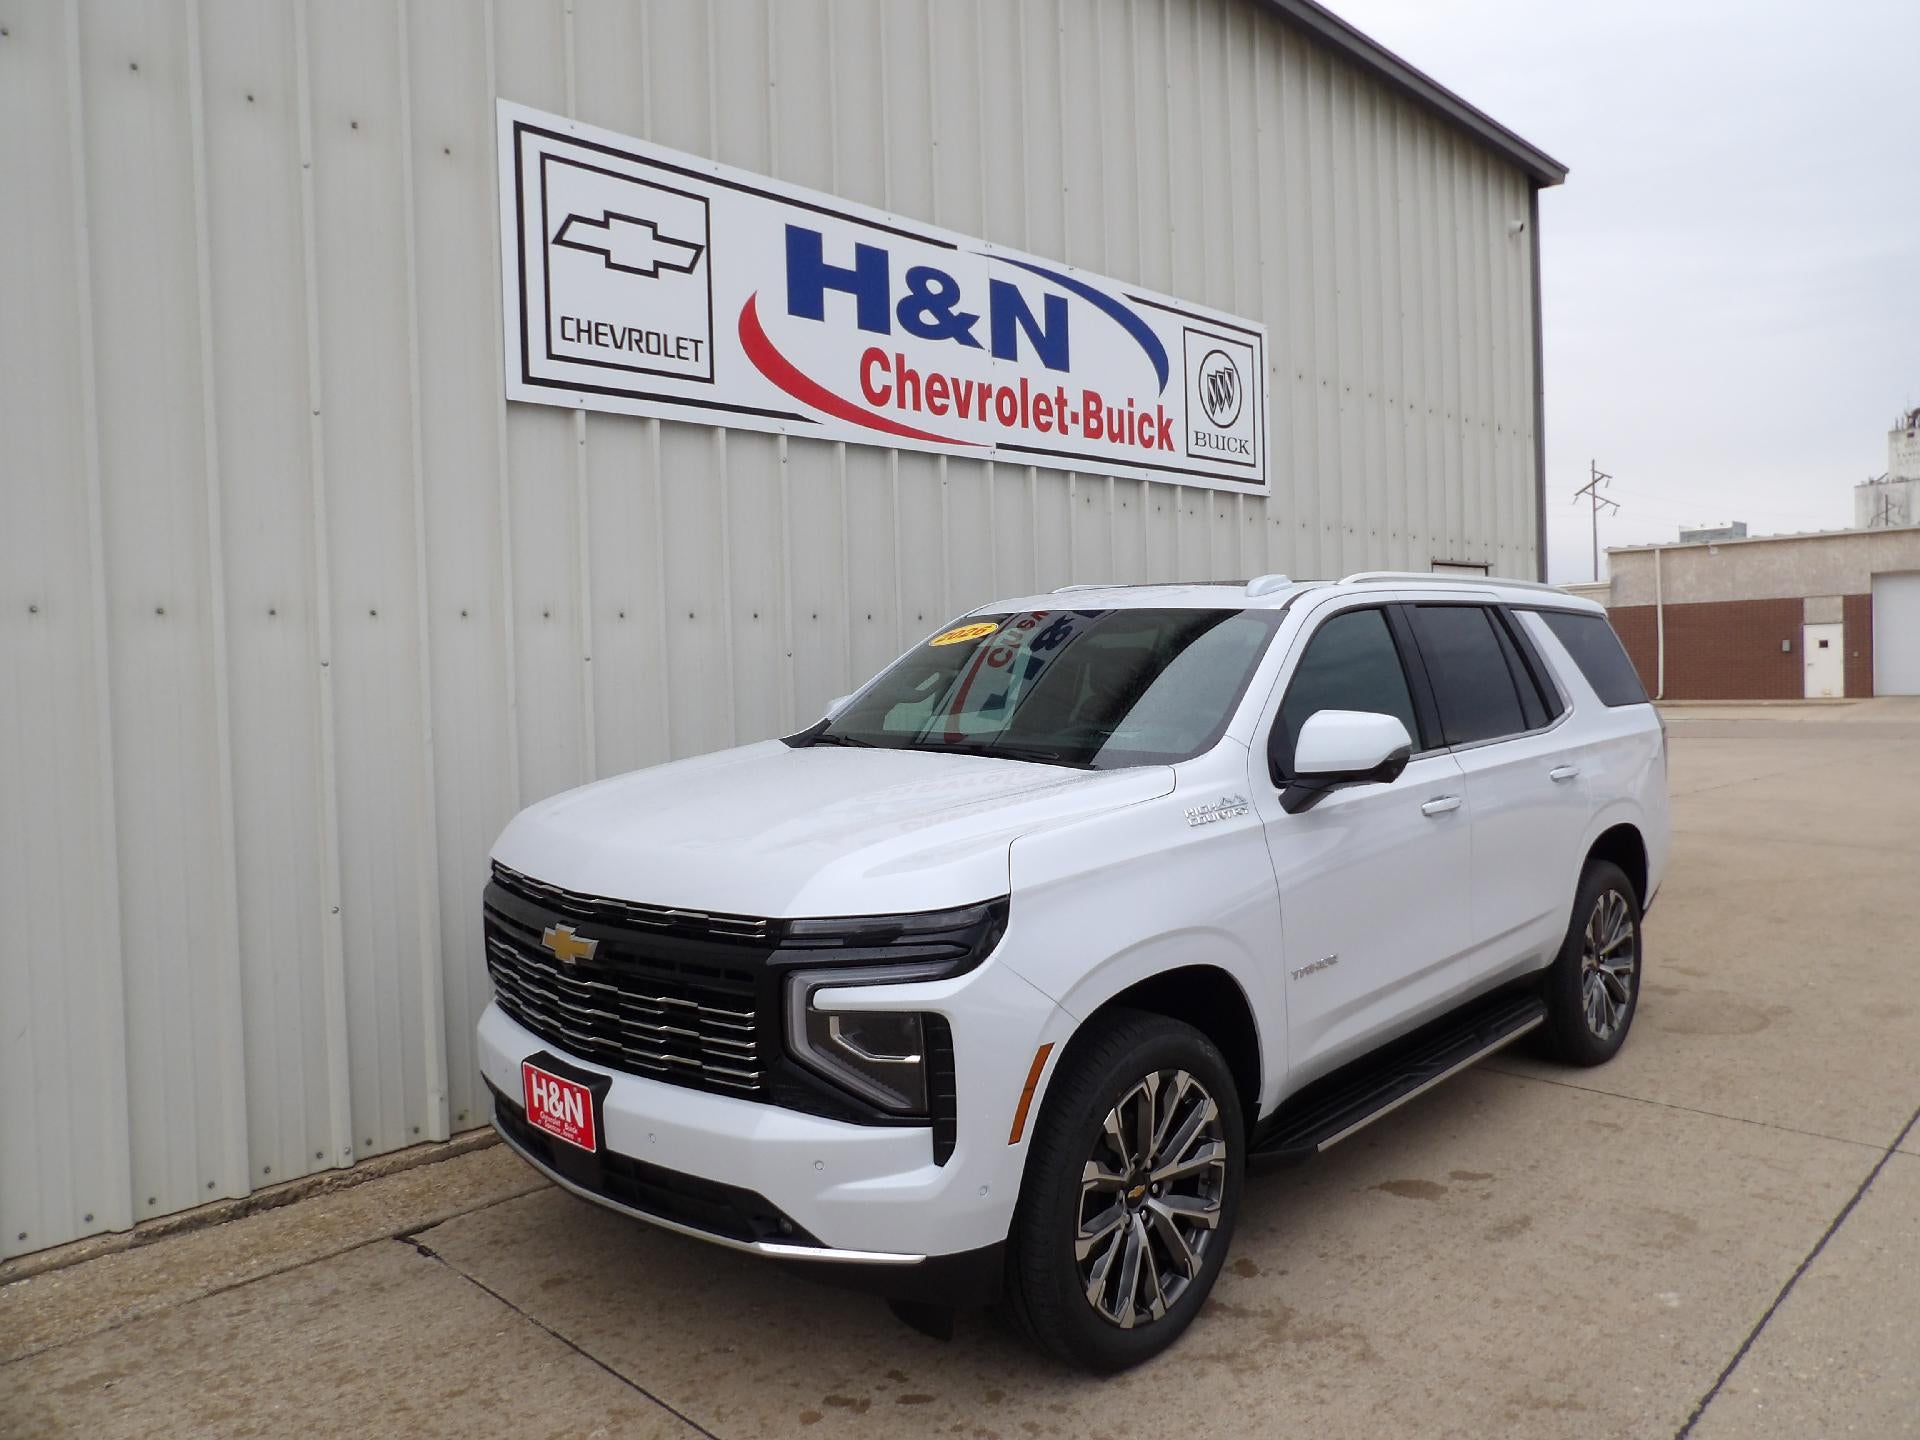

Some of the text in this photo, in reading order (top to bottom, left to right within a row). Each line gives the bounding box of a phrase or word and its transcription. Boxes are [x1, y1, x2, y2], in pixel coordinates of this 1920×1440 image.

[784, 223, 1070, 373] H&N
[560, 316, 704, 362] CHEVROLET
[860, 346, 1176, 453] Chevrolet-Buick
[1193, 430, 1250, 455] BUICK
[531, 1073, 584, 1129] H&N
